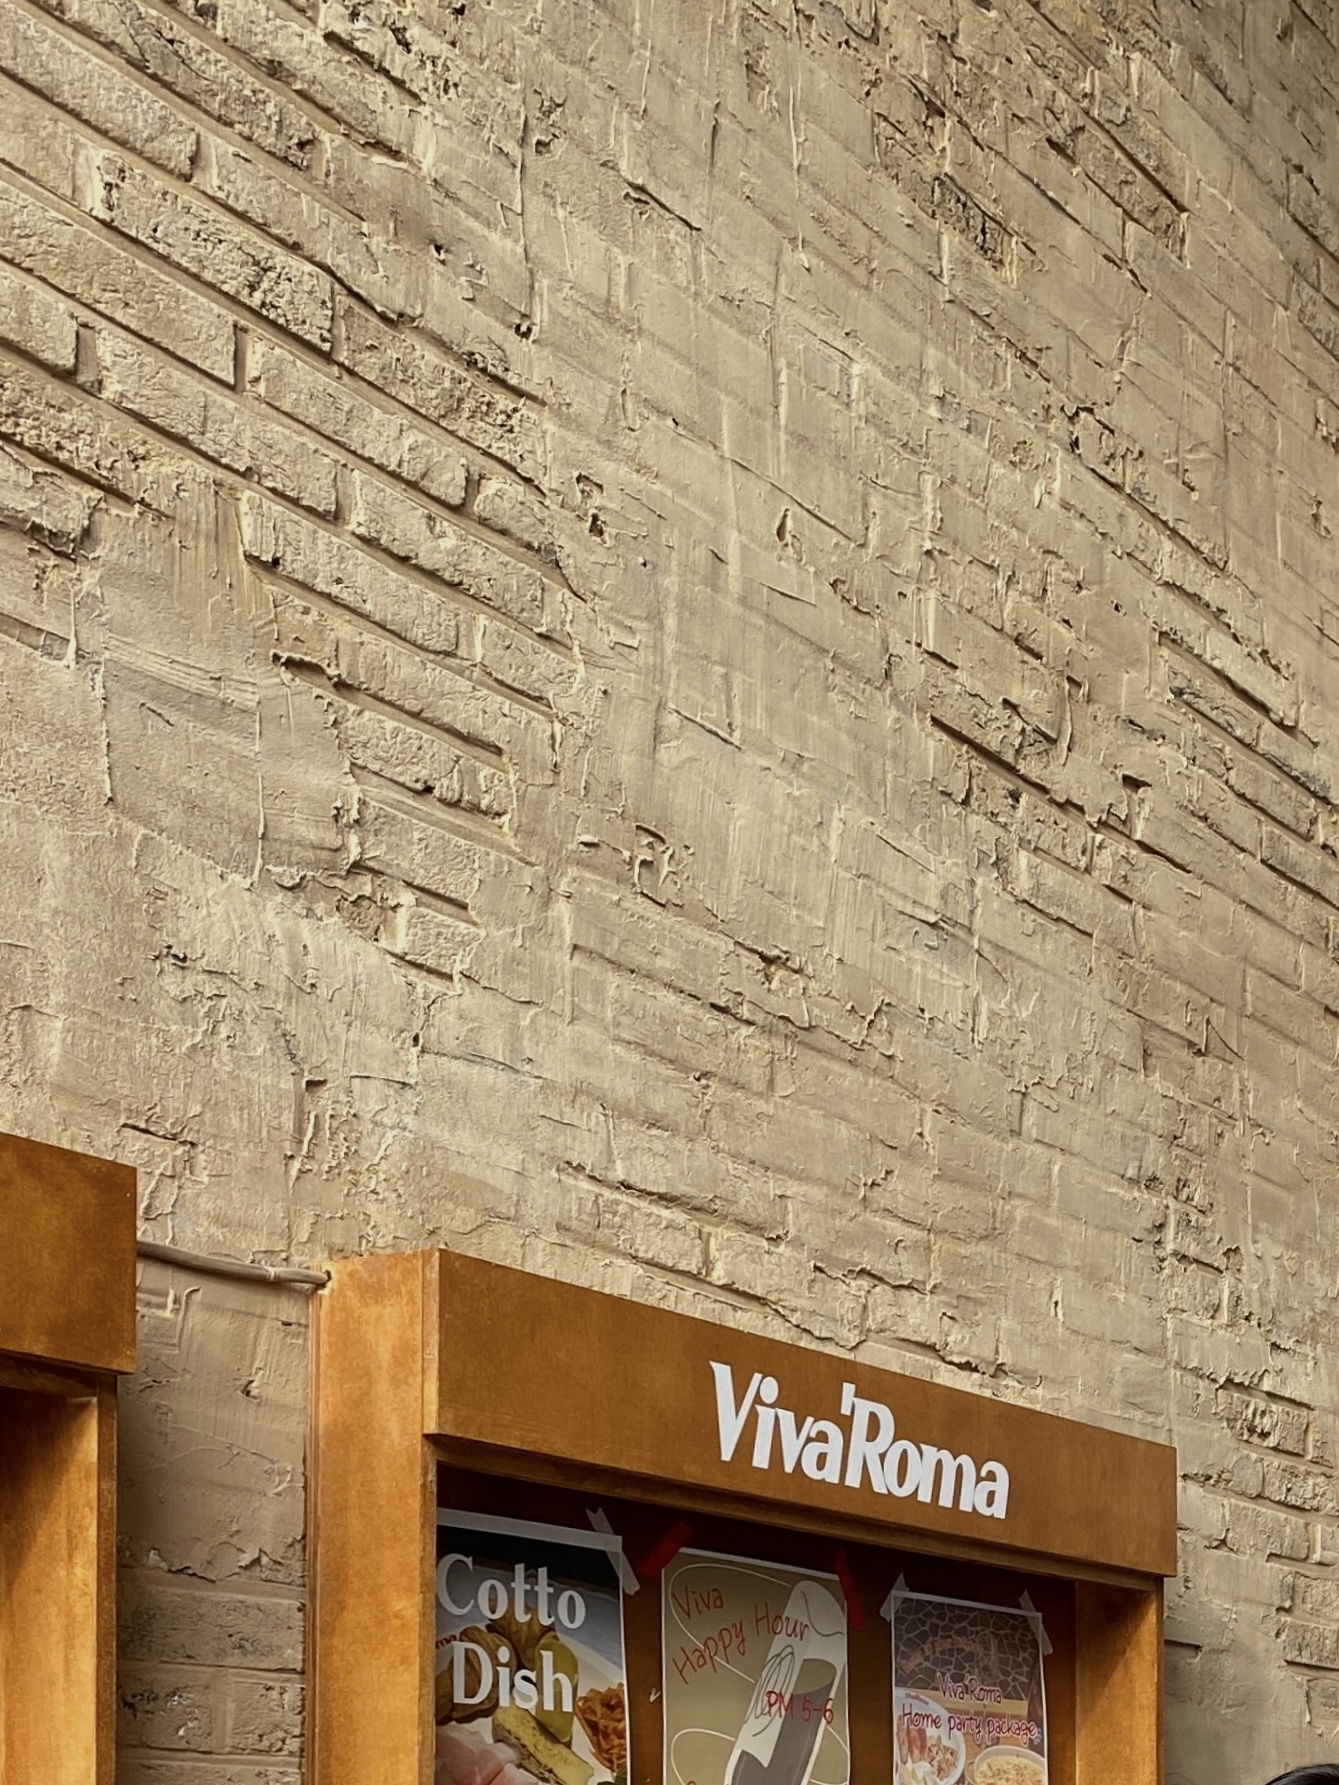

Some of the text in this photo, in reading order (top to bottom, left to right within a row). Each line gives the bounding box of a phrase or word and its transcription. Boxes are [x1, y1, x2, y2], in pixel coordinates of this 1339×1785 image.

[709, 1360, 1009, 1519] Viva'Roma
[436, 1553, 586, 1629] Cotto
[672, 1585, 724, 1620] Viva
[450, 1641, 573, 1712] Dish
[672, 1602, 809, 1685] Happy Hour
[765, 1690, 834, 1724] PM 5-6
[901, 1703, 1038, 1747] Home party package
